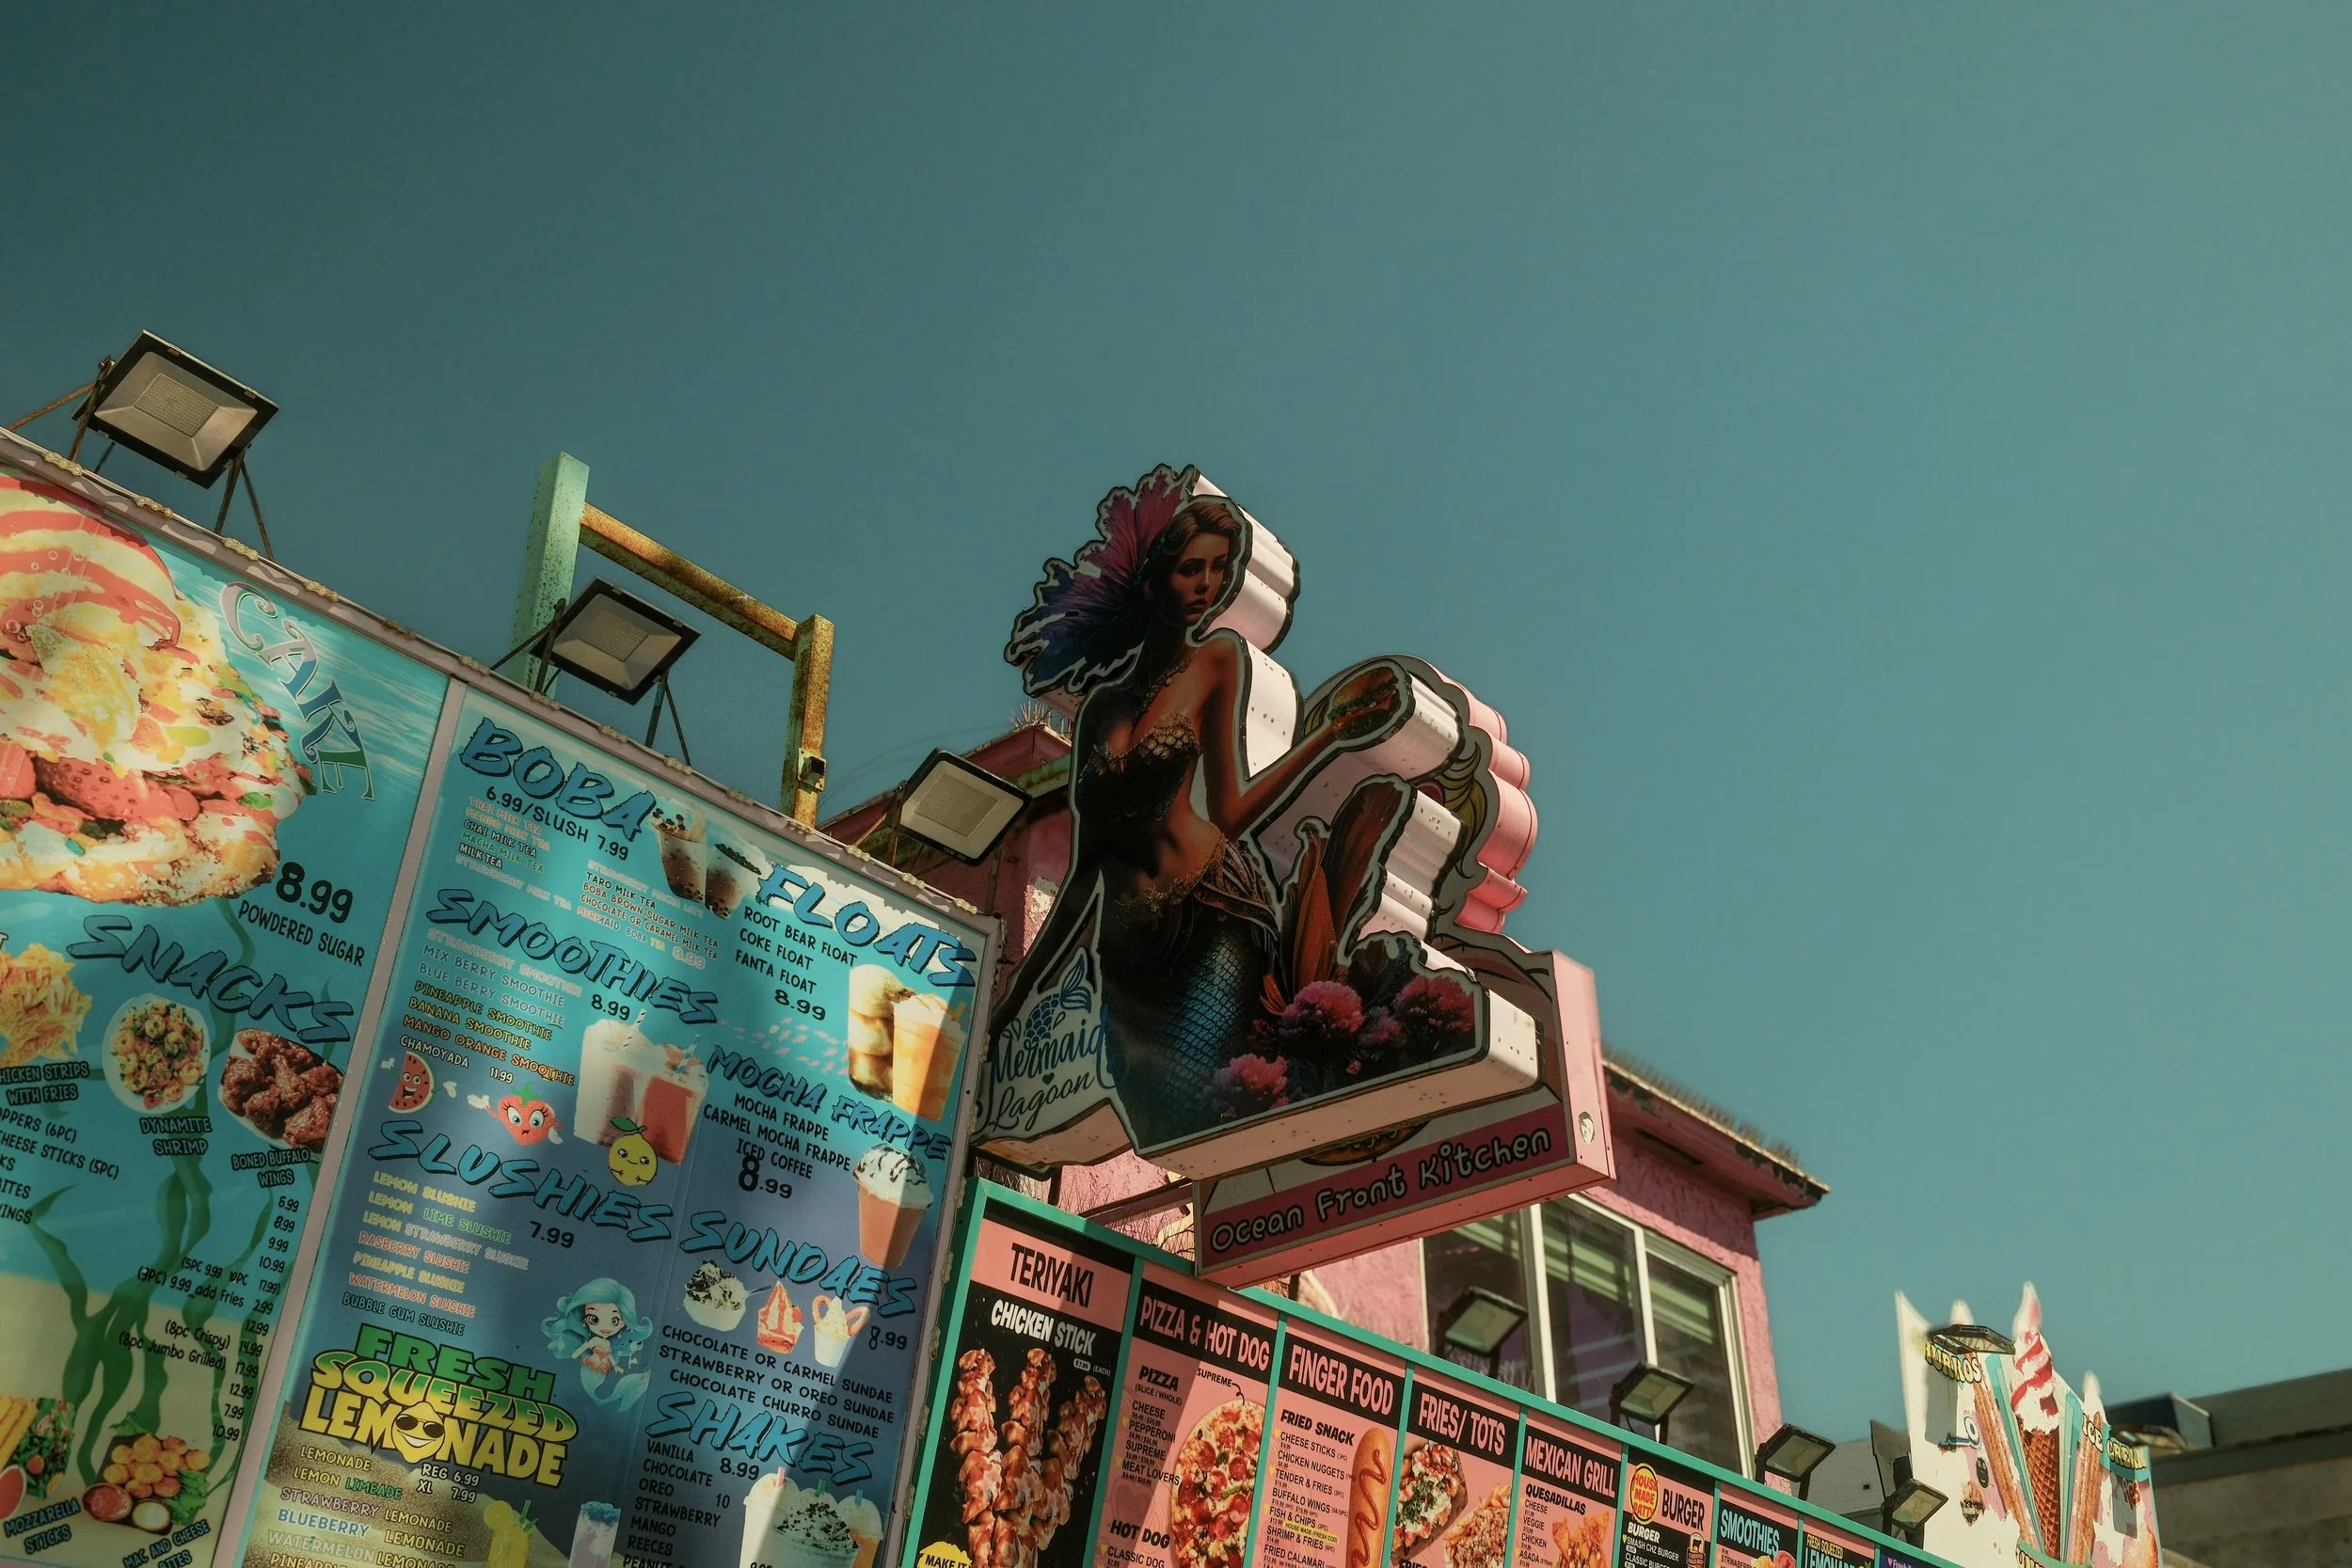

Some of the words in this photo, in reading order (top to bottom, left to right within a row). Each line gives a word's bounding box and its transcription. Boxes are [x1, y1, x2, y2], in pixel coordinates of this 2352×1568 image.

[220, 581, 374, 800] CAKE
[459, 717, 657, 842] BOBA
[465, 819, 488, 836] CHAI
[491, 831, 515, 847] MILK
[518, 843, 536, 857] TEA
[597, 834, 629, 861] 7.99
[276, 862, 354, 924] 8.99
[587, 871, 612, 889] TARO
[614, 884, 637, 899] MILK
[641, 895, 657, 910] TEA
[238, 900, 313, 946] POWDERED
[318, 932, 365, 967] SUGAR
[744, 906, 781, 932] ROOT
[784, 923, 817, 950] BEAR
[821, 941, 857, 967] FLOAT
[755, 863, 977, 988] FLOATS
[426, 888, 718, 1024] SMOOTHIES
[739, 927, 771, 953] COKE
[776, 943, 814, 971] FLOAT
[66, 914, 354, 1042] SNACKS
[423, 943, 449, 963] MIX
[453, 954, 497, 981] BERRY
[501, 974, 564, 1007] SMOOTHIE
[735, 949, 774, 978] FANTA
[780, 968, 817, 994] FLOAT
[414, 981, 483, 1015] PINEAPPLE
[488, 1008, 553, 1042] SMOOTHIE
[591, 993, 630, 1021] 8.99
[774, 989, 826, 1021] 8.99
[409, 997, 460, 1025] BANANA
[466, 1018, 532, 1052] SMOOTHIE
[400, 1035, 469, 1069] CHAMOYADA
[991, 1003, 1114, 1088] Mermaid
[0, 1066, 40, 1084] HICKEN
[44, 1061, 89, 1080] STRIPS
[7, 1087, 40, 1105] WITH
[42, 1084, 79, 1102] FRIES
[707, 1045, 827, 1114] MOCHA
[832, 1095, 952, 1161] FRAPPE
[989, 1071, 1095, 1132] Lagoon
[139, 1116, 213, 1135] DYNAMITE
[735, 1093, 777, 1122] MOCHA
[783, 1113, 829, 1142] FRAPPE
[152, 1137, 208, 1156] SHRIMP
[704, 1103, 752, 1134] CARMEL
[757, 1124, 800, 1154] MOCHA
[805, 1144, 850, 1172] FRAPPE
[230, 1151, 266, 1170] BONED
[267, 1148, 310, 1166] BUFFALO
[736, 1137, 765, 1162] ICED
[771, 1151, 813, 1180] COFFEE
[258, 1169, 295, 1189] WINGS
[367, 1119, 673, 1243] SLUSHIES
[1211, 1205, 1304, 1254] Ocean
[1316, 1164, 1407, 1223] Front
[1419, 1127, 1552, 1190] Kitchen
[368, 1191, 413, 1214] LEMON
[423, 1207, 453, 1227] LIME
[459, 1219, 513, 1244] SLUSHIE
[529, 1220, 575, 1248] 7.99
[259, 1256, 285, 1274] 10.99
[358, 1230, 421, 1259] RASBERRY
[424, 1249, 470, 1274] SLUSHIE
[679, 1211, 917, 1317] SUNDAES
[1009, 1243, 1094, 1308] TERIYAKI
[165, 1320, 189, 1339] (8pc
[194, 1327, 230, 1352] Crispy)
[239, 1339, 263, 1357] 14.99
[246, 1319, 269, 1337] 12.99
[991, 1299, 1055, 1343] CHICKEN
[1054, 1321, 1097, 1356] STICK
[1139, 1295, 1185, 1342] PIZZA
[1189, 1314, 1201, 1347] &
[1204, 1320, 1237, 1358] HOT
[1237, 1332, 1270, 1371] DOG
[355, 1323, 557, 1406] FRESH
[662, 1324, 748, 1360] CHOCOLATE
[755, 1353, 776, 1370] OR
[783, 1360, 835, 1386] CARMEL
[842, 1378, 893, 1404] SUNDAE
[1138, 1365, 1180, 1392] PIZZA
[1197, 1368, 1233, 1387] SUPREME
[1288, 1344, 1347, 1400] FINGER
[1349, 1368, 1394, 1416] FOOD
[230, 1383, 254, 1400] 12.99
[310, 1350, 579, 1444] SQUEEZED
[660, 1345, 765, 1386] STRAWBERRY
[771, 1377, 792, 1394] OR
[799, 1386, 837, 1406] OREO
[843, 1399, 894, 1424] SUNDAE
[670, 1369, 755, 1403] CHOCOLATE
[762, 1395, 821, 1421] CHURRO
[827, 1415, 879, 1439] SUNDAE
[1132, 1400, 1166, 1419] CHEESE
[212, 1424, 239, 1442] 10.99
[645, 1391, 876, 1486] SHAKES
[1129, 1419, 1175, 1444] PEPPERONI
[1280, 1409, 1312, 1432] FRIED
[1314, 1421, 1356, 1447] SNACK
[1470, 1412, 1506, 1456] TOTS
[2082, 1413, 2104, 1453] ICE
[300, 1445, 372, 1472] LEMONADE
[647, 1439, 694, 1464] VANILLA
[1125, 1439, 1166, 1461] SUPREME
[1279, 1431, 1310, 1449] CHEESE
[1311, 1442, 1336, 1458] STICKS
[421, 1463, 448, 1481] REG
[453, 1469, 480, 1487] 6.99
[643, 1459, 713, 1487] CHOCOLATE
[719, 1457, 760, 1481] 8.99
[1122, 1459, 1146, 1476] MEAT
[1146, 1467, 1180, 1486] LOVERS
[1278, 1449, 1310, 1468] CHICKEN
[1311, 1461, 1345, 1481] NUGGETS
[1525, 1435, 1582, 1484] MEXICAN
[1583, 1459, 1615, 1498] GRILL
[293, 1465, 341, 1487] LEMON
[345, 1477, 403, 1500] LIMEADE
[416, 1480, 433, 1494] XL
[451, 1487, 477, 1503] 7.99
[638, 1478, 675, 1497] OREO
[1633, 1473, 1659, 1491] HOUSE
[1634, 1488, 1656, 1505] MADE
[280, 1487, 380, 1517] STRAWBERRY
[384, 1509, 453, 1533] LEMONADE
[634, 1497, 722, 1528] STRAWBERRY
[1272, 1487, 1306, 1506] BUFFALO
[1307, 1497, 1330, 1513] WINGS
[1524, 1498, 1548, 1514] CHEESE
[1525, 1483, 1586, 1515] QUESADILLAS
[1631, 1503, 1655, 1518] PATTY
[1661, 1488, 1705, 1531] BURGER
[4, 1497, 81, 1538] MOZZARELLA
[630, 1515, 676, 1537] MANGO
[1269, 1506, 1286, 1519] FISH
[1287, 1512, 1293, 1521] &
[1295, 1514, 1316, 1528] CHIPS
[1285, 1523, 1299, 1531] HOUSE
[1300, 1527, 1311, 1536] MADE
[1312, 1530, 1327, 1540] (FRESH
[1523, 1515, 1545, 1530] VEGGIE
[1628, 1521, 1661, 1544] BURGER
[1720, 1509, 1780, 1557] SMOOTHIES
[24, 1524, 72, 1554] STICKS
[278, 1509, 371, 1538] BLUEBERRY
[385, 1529, 466, 1558] LEMONADE
[1110, 1519, 1141, 1540] HOT
[1142, 1528, 1170, 1549] DOG
[1521, 1532, 1548, 1548] CHICKEN
[1627, 1536, 1646, 1550] SMASH
[1646, 1544, 1657, 1553] CHZ
[1658, 1547, 1679, 1561] BURGER
[1806, 1533, 1821, 1549] FRESH
[1821, 1539, 1844, 1559] SQUEEZED
[1107, 1546, 1144, 1565] CLASSIC
[1146, 1556, 1165, 1568] DOG
[1519, 1550, 1539, 1563] ASADA
[1625, 1552, 1648, 1567] CLASSIC
